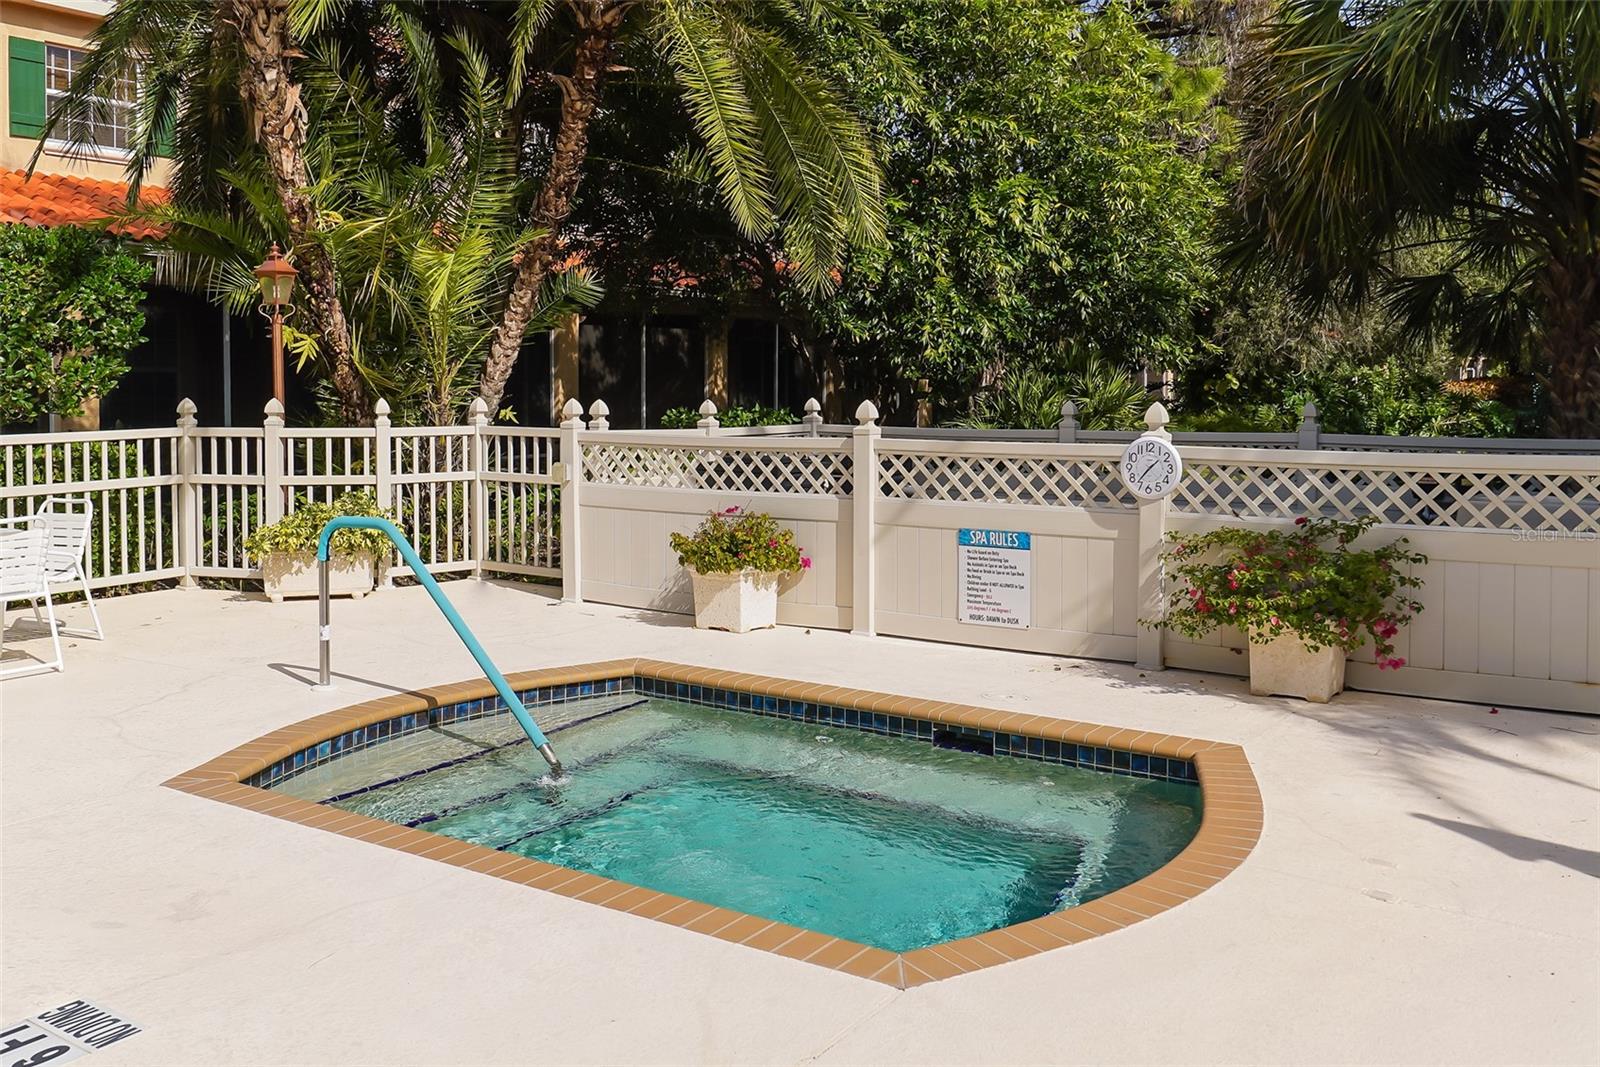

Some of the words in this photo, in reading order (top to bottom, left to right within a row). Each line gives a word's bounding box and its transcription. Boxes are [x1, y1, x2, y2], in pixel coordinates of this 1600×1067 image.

[1138, 445, 1143, 454] 11
[1146, 442, 1155, 453] 12
[1128, 452, 1138, 462] 10
[1164, 452, 1170, 462] 2
[1126, 463, 1132, 473] 9
[1167, 464, 1173, 474] 3
[1129, 473, 1136, 483] 8
[1162, 475, 1169, 484] 4
[1137, 481, 1143, 491] 7
[1145, 484, 1152, 494] 6
[1155, 482, 1162, 492] 5
[970, 531, 987, 544] SPA
[990, 532, 1019, 547] RULES
[38, 1000, 122, 1038] DIVING
[84, 1024, 142, 1049] NO
